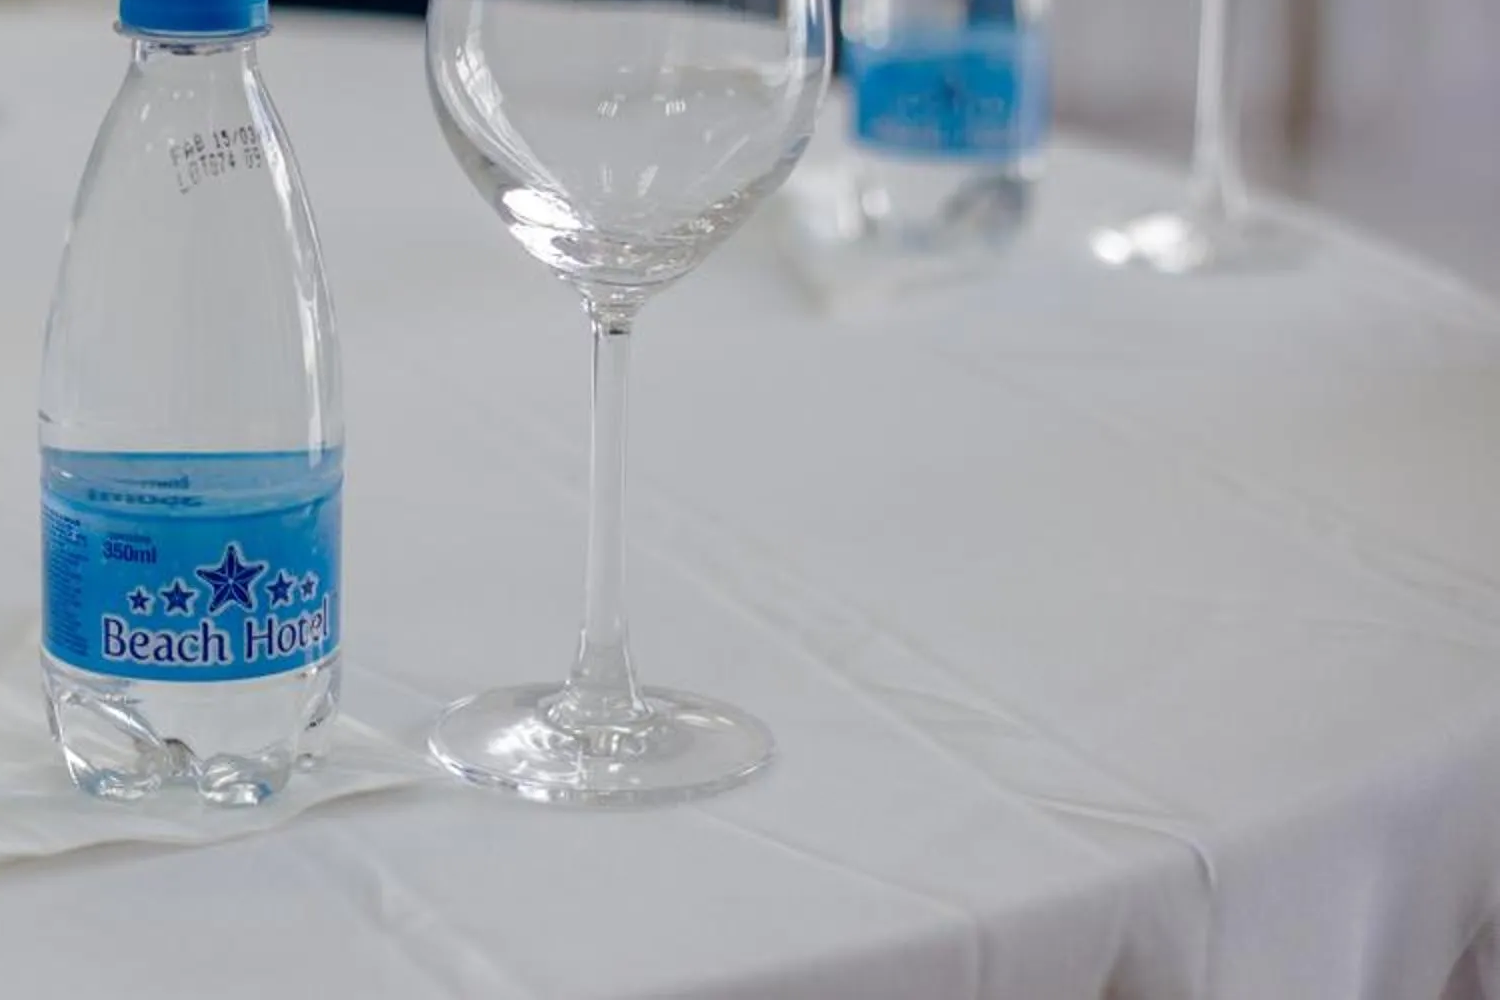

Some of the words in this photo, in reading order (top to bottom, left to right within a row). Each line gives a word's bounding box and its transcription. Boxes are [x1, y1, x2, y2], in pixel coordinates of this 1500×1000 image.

[102, 540, 158, 565] 350ml
[102, 616, 229, 663] Beach
[244, 600, 330, 660] Hotel
